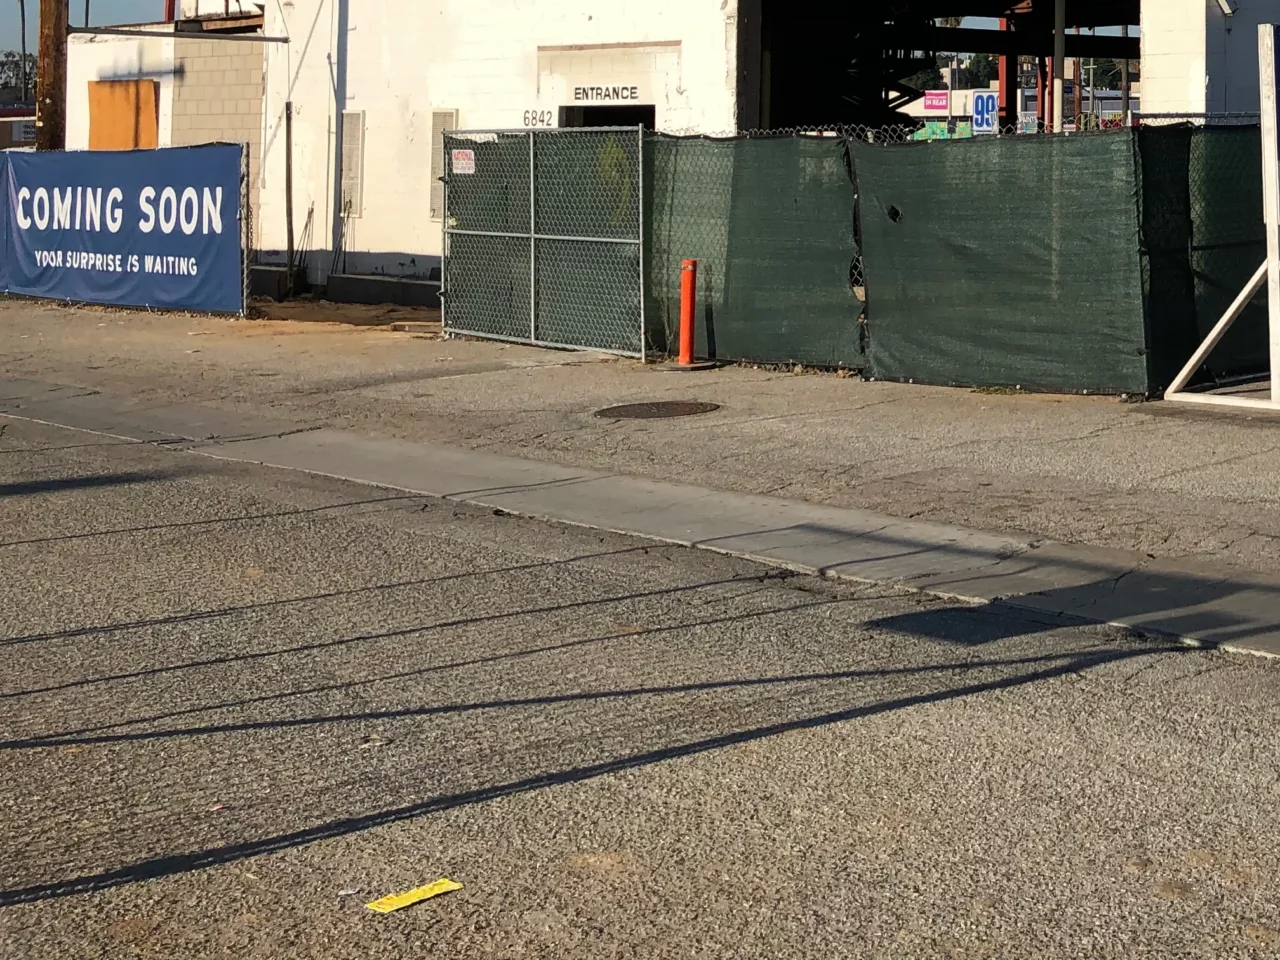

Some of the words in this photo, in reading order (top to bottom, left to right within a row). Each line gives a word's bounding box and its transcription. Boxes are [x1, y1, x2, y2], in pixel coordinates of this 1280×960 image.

[574, 86, 639, 101] ENTRANCE
[523, 110, 553, 127] 6842
[974, 94, 1000, 128] 99
[17, 186, 123, 233] COMING
[139, 185, 222, 235] SOON
[35, 250, 63, 268] YOUR
[66, 250, 122, 272] SURPRISE
[127, 254, 140, 273] IS
[144, 255, 198, 276] WAITING
